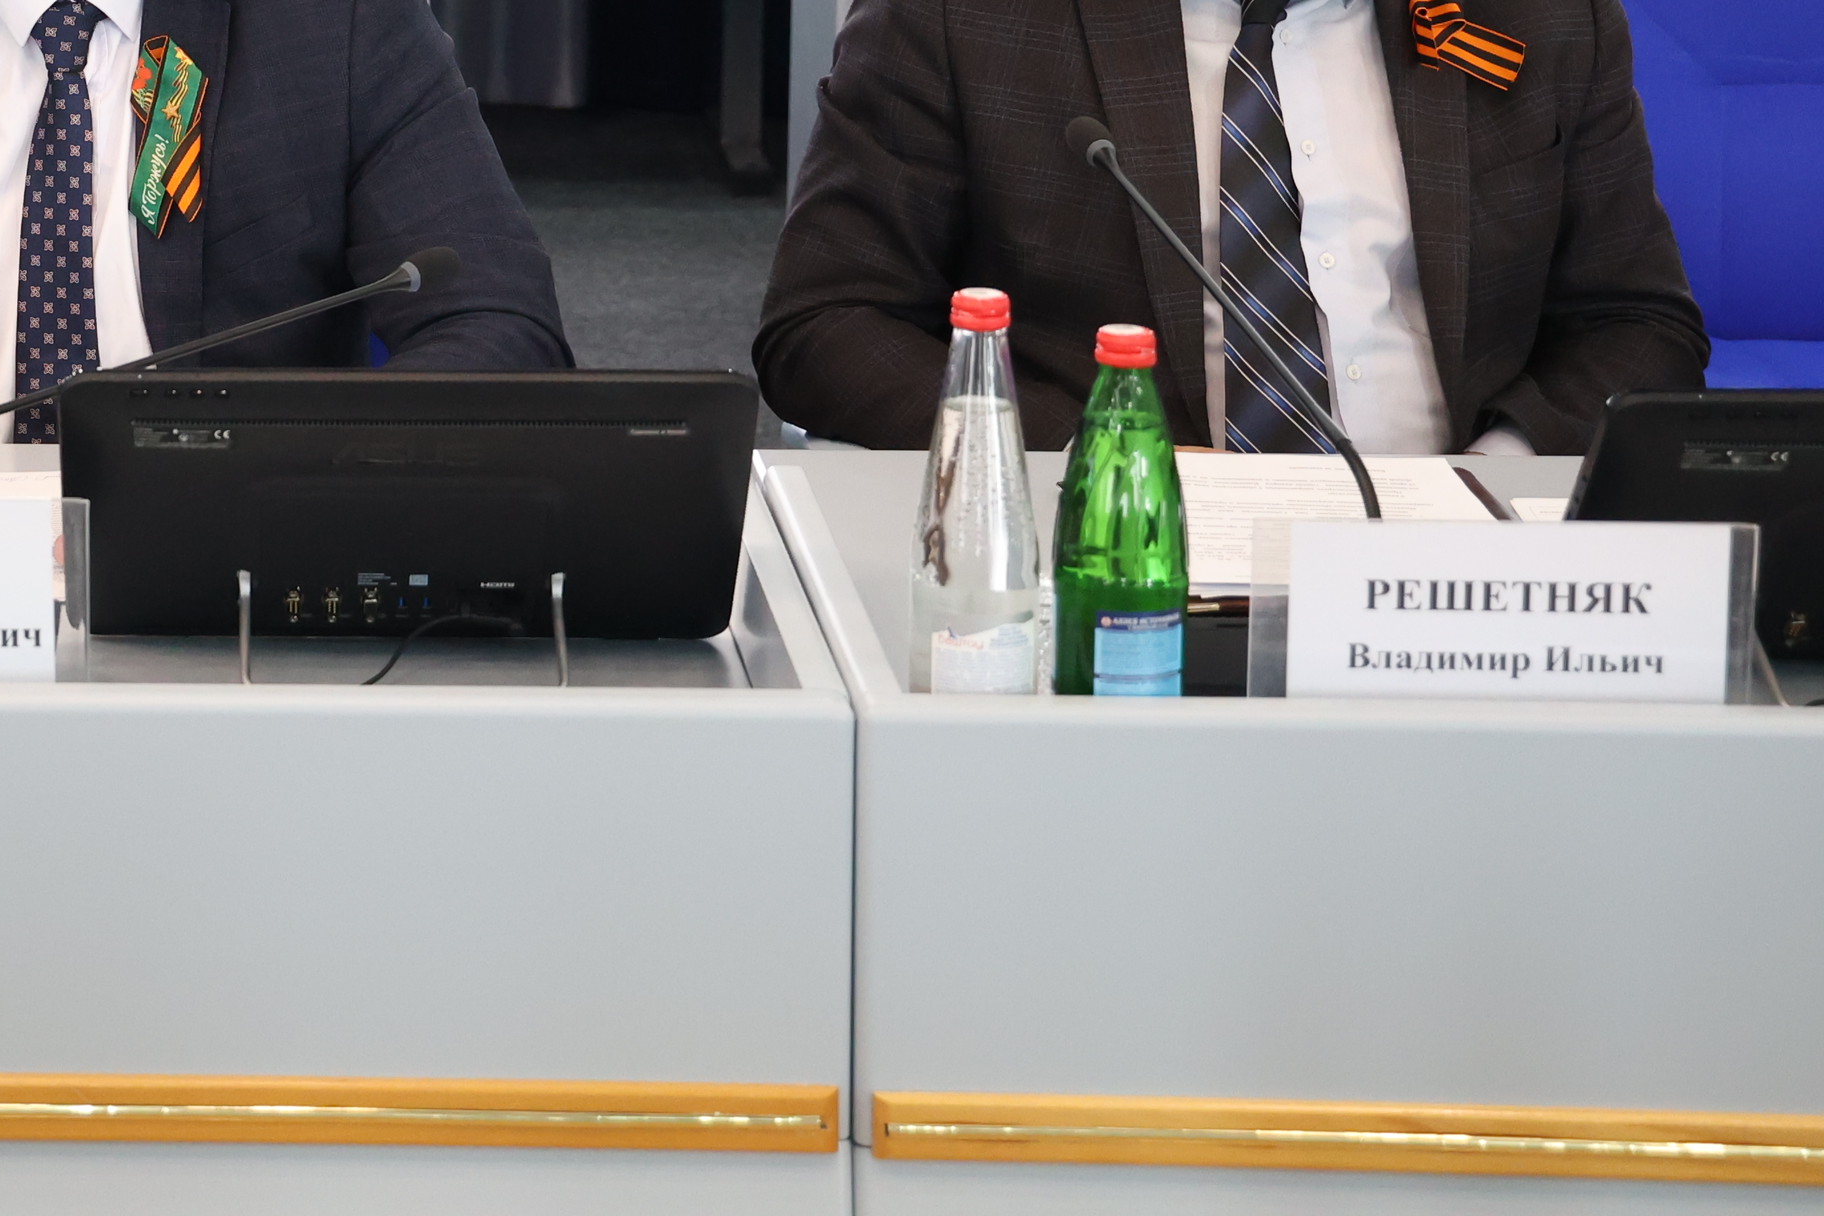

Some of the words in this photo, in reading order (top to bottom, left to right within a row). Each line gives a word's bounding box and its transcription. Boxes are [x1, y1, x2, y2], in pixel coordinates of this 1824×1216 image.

[141, 204, 156, 225] Я
[1365, 579, 1654, 615] РЕШЕТНЯК
[1348, 644, 1532, 680] Владимир
[1545, 647, 1665, 674] Ильич
